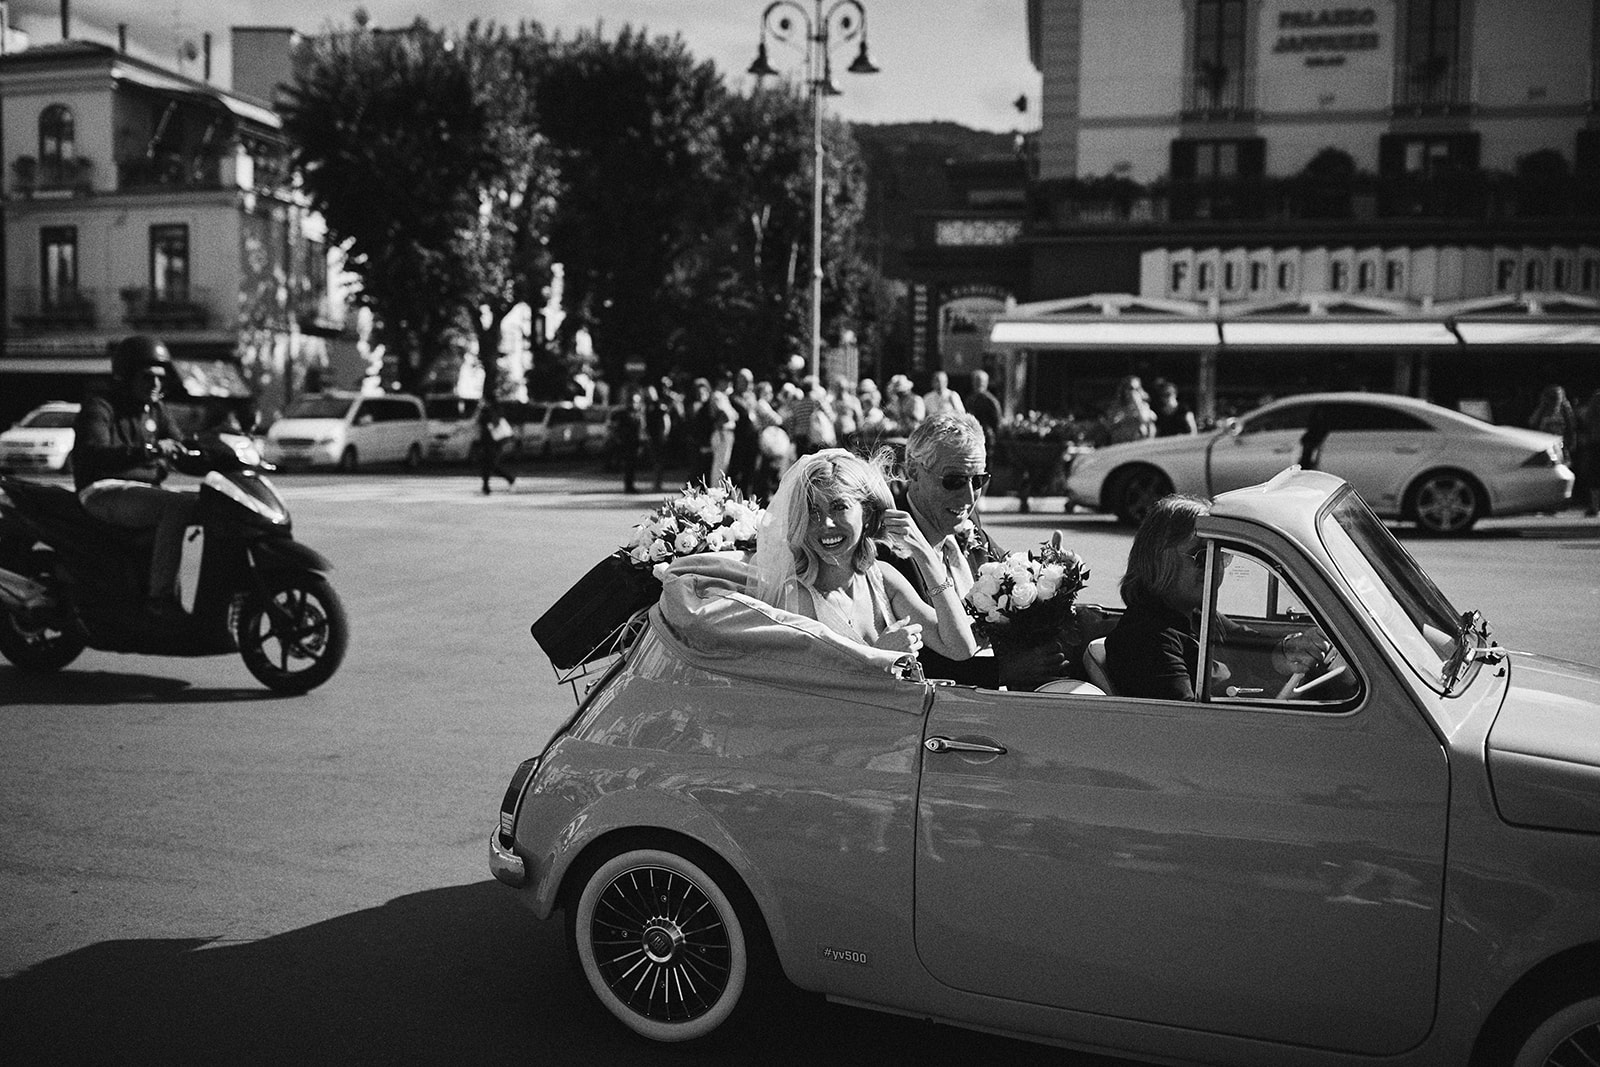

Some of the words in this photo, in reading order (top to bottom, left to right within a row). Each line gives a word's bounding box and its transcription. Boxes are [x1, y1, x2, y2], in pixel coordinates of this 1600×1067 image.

[1171, 260, 1296, 292] FAUNO
[1331, 260, 1405, 292] BAR
[823, 947, 867, 963] #yv500
